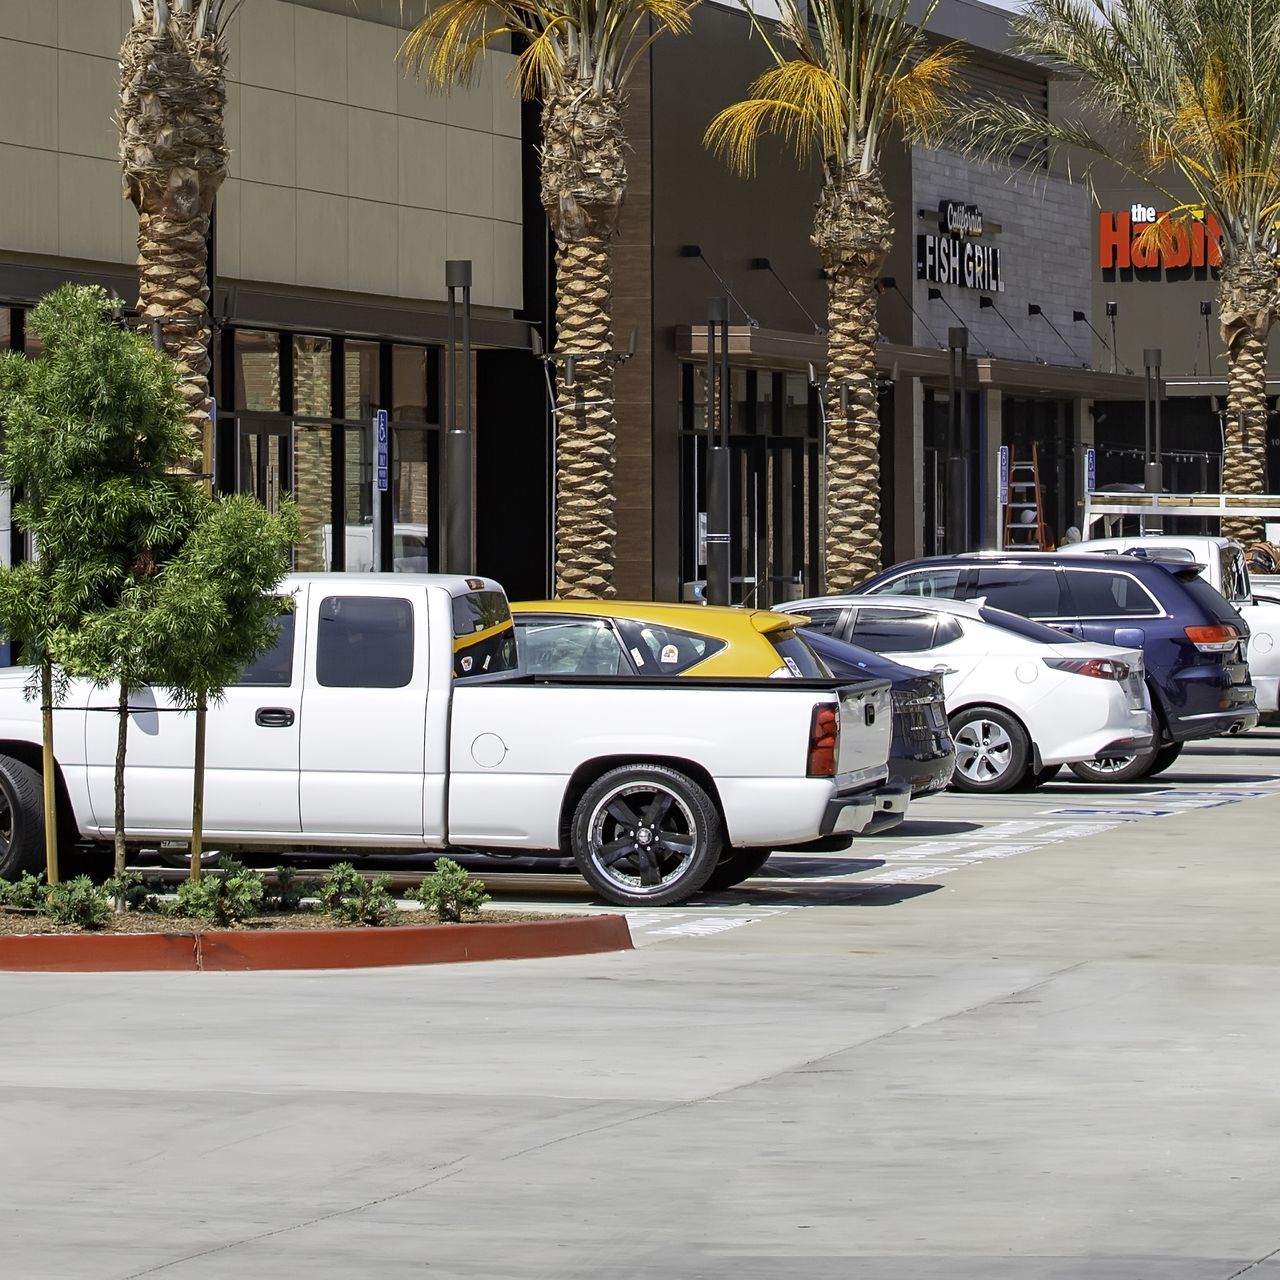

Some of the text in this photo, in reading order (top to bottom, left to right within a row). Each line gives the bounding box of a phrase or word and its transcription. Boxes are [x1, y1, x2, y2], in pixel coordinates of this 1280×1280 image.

[1131, 204, 1156, 223] the
[926, 235, 1005, 293] FISH GRILL
[1271, 438, 1280, 446] 10
